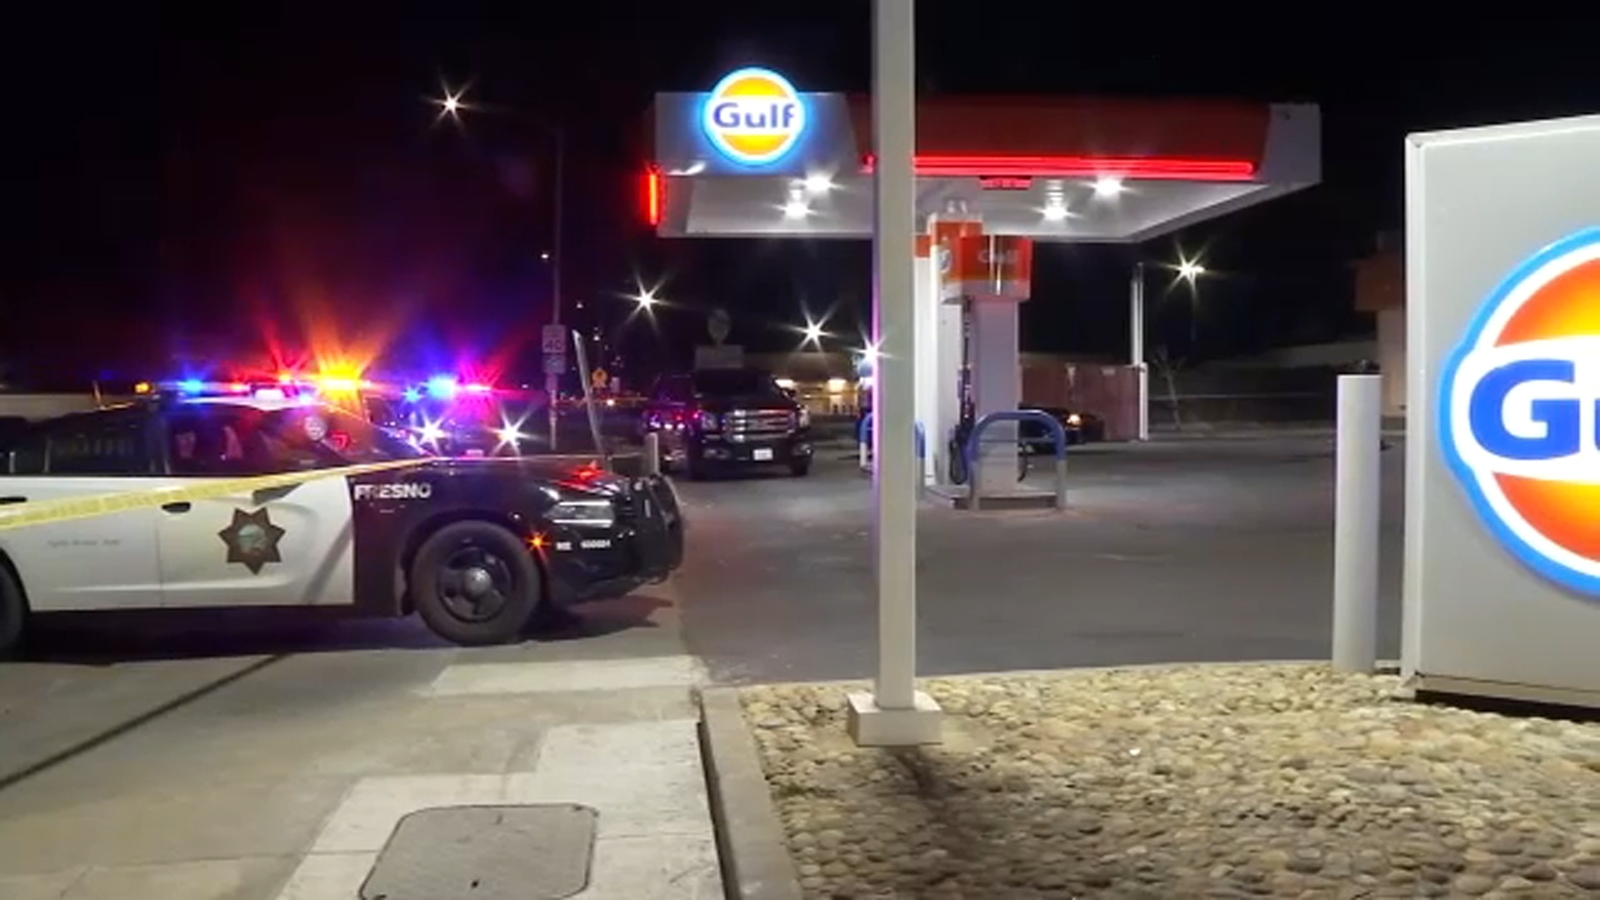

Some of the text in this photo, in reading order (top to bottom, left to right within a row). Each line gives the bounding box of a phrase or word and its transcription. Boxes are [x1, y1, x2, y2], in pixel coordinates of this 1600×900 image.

[712, 101, 795, 129] Gulf
[1468, 358, 1600, 461] G
[354, 483, 432, 501] FRESNO
